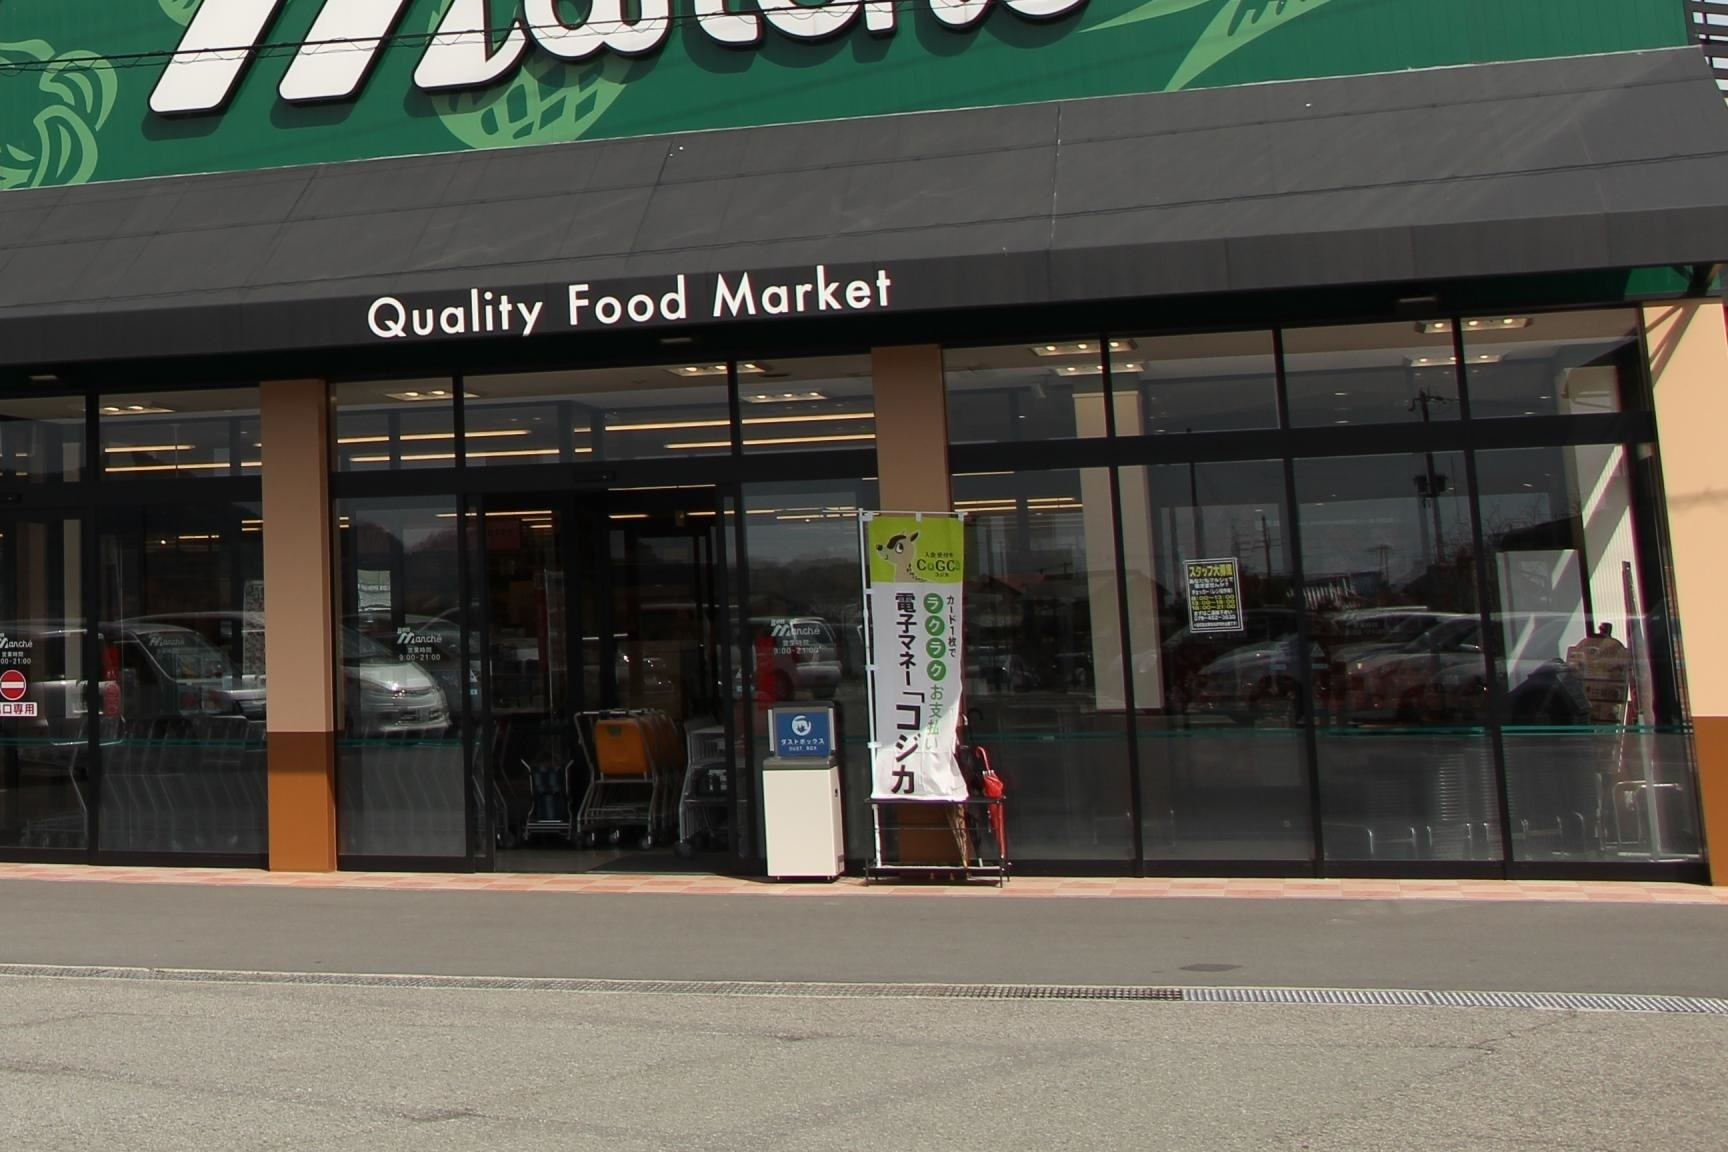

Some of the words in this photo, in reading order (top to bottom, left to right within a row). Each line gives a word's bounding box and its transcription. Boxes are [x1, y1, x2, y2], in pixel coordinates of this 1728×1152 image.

[367, 288, 543, 338] Quality
[568, 273, 687, 326] Food
[712, 264, 891, 318] Market
